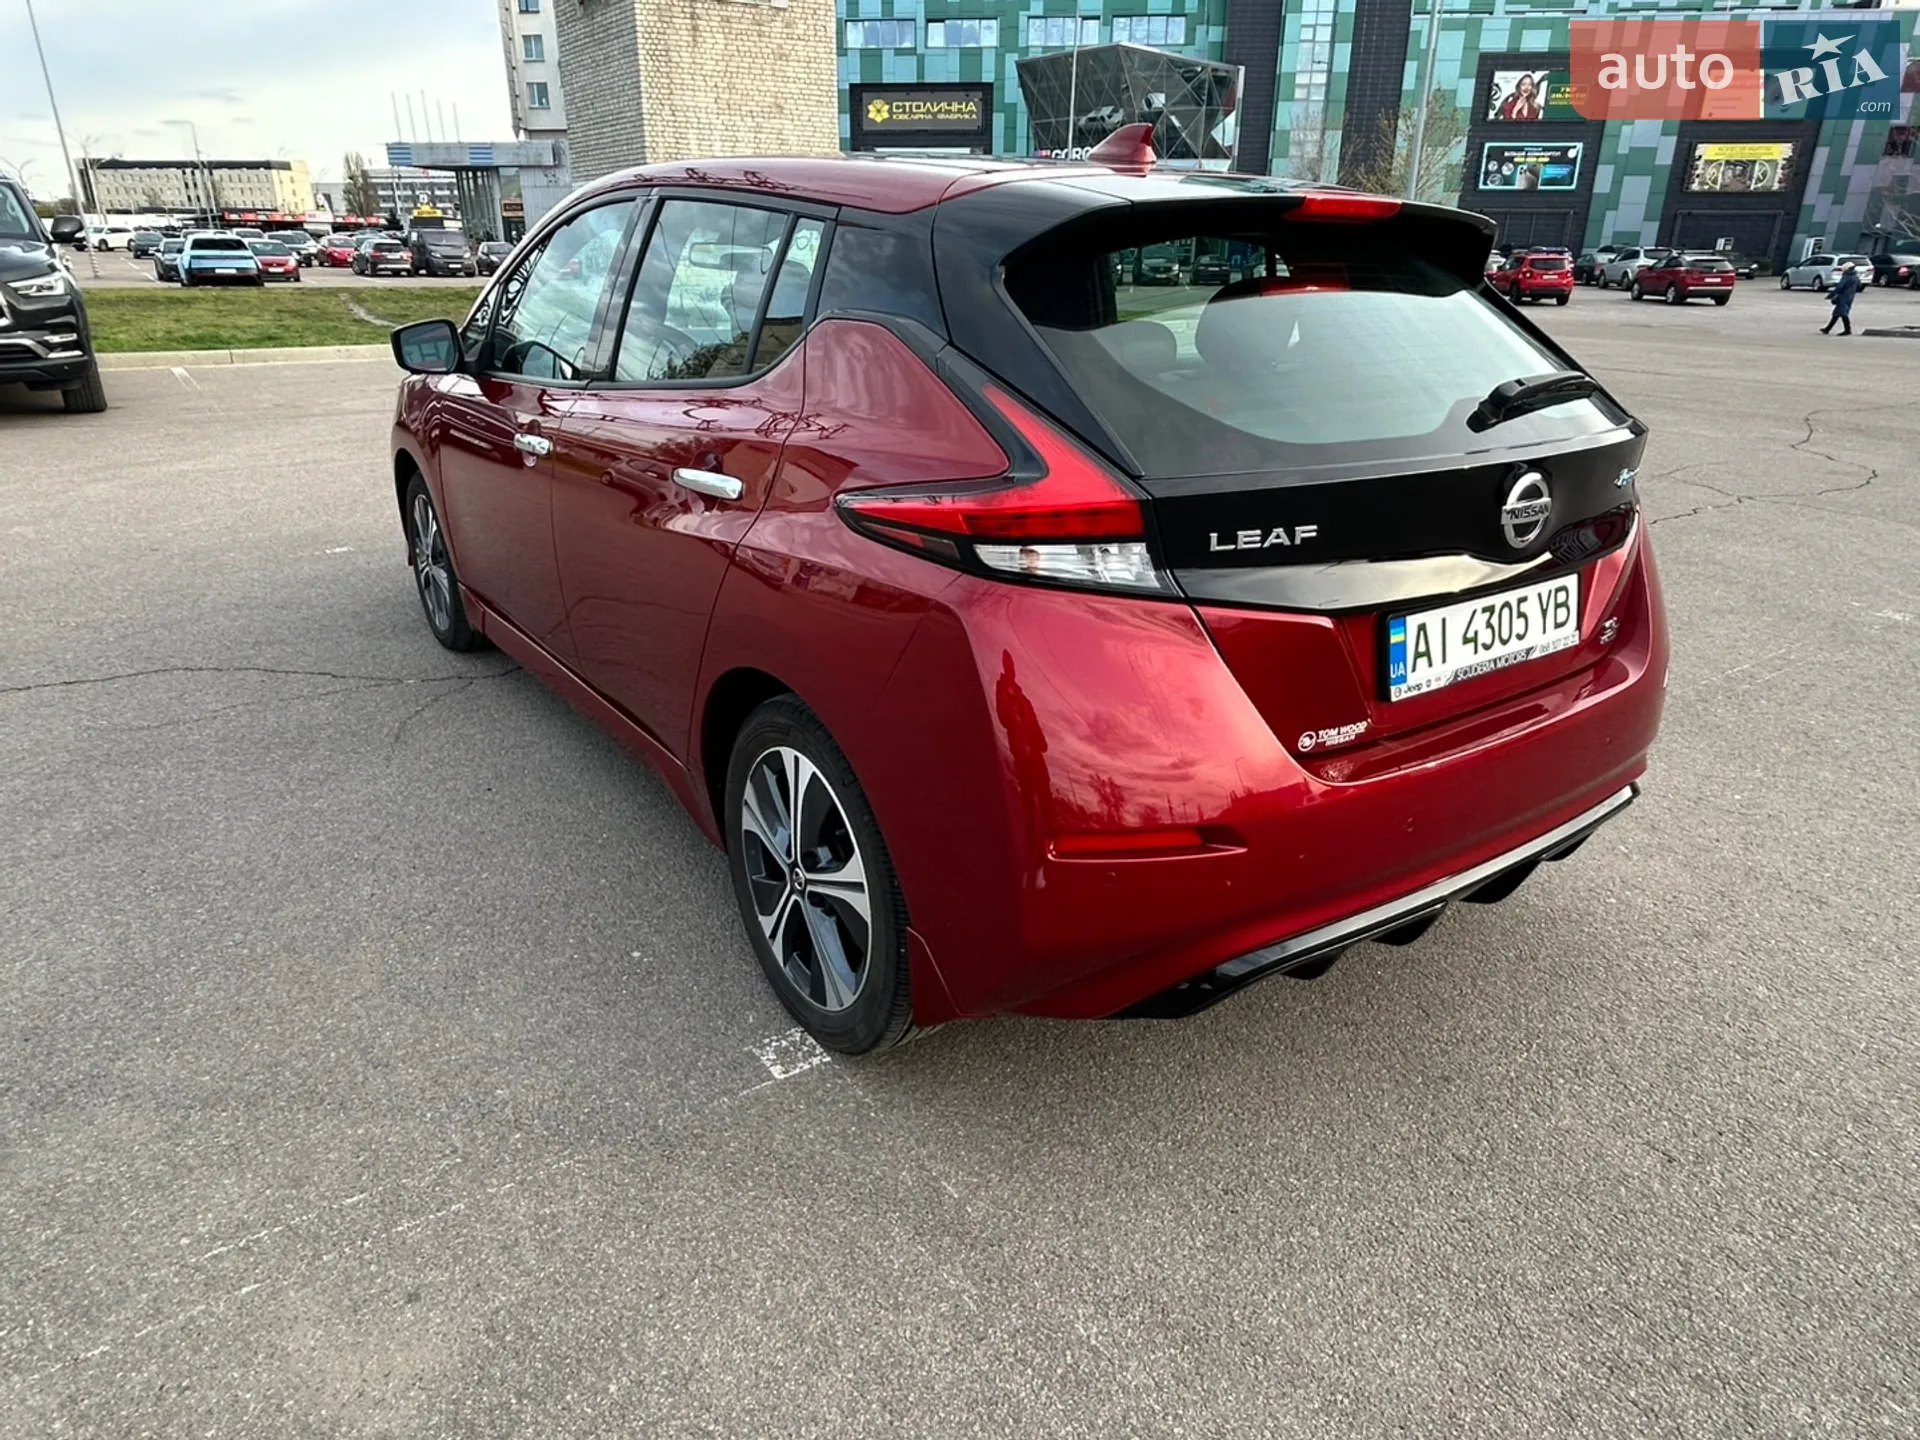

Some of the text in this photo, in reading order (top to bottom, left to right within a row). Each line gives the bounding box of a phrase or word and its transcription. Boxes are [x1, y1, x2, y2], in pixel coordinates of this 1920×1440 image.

[892, 101, 977, 112] СТОЛИЧНА
[1507, 503, 1549, 520] NISSAN
[1209, 523, 1318, 552] LEAF
[1411, 617, 1446, 673] AI
[1461, 595, 1529, 655] 4305
[1537, 585, 1571, 635] YB
[1390, 663, 1406, 679] UA
[1457, 650, 1527, 681] SCUDERIA MOTORS
[1403, 680, 1423, 695] Jeep
[1318, 720, 1368, 739] TOM WOOD
[1325, 734, 1356, 747] NISSAN
